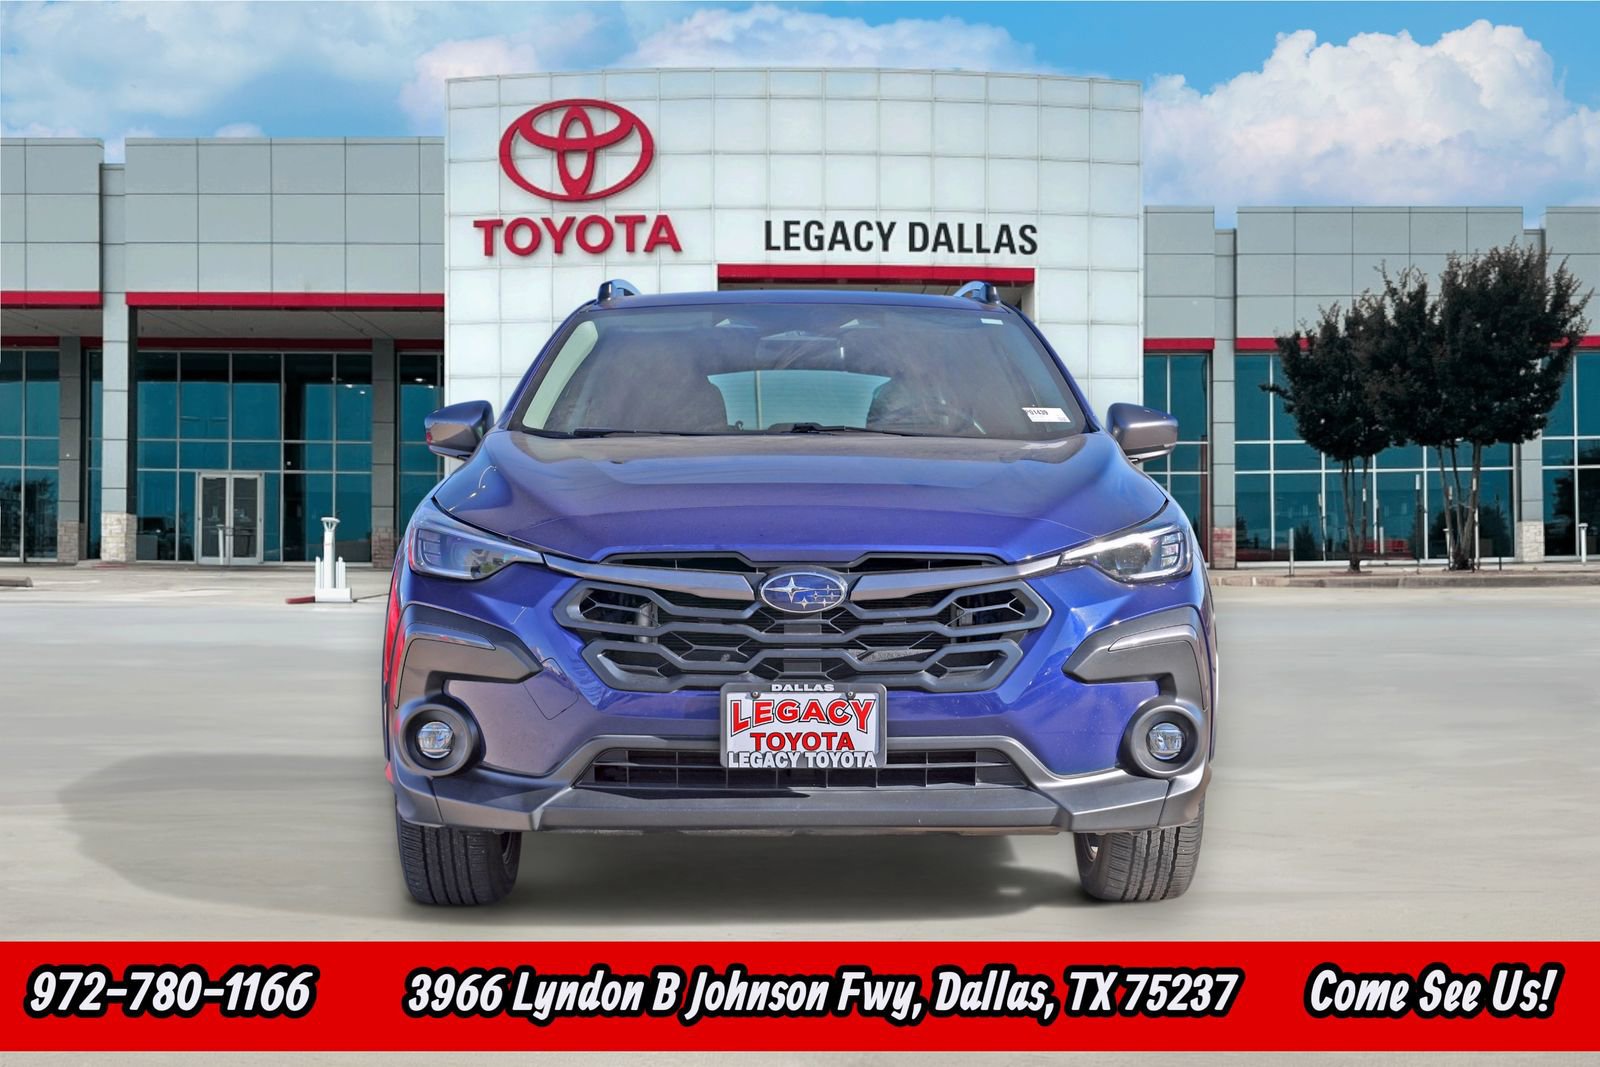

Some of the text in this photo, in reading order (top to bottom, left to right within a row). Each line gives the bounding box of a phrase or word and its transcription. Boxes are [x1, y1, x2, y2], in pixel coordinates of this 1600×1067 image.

[473, 215, 682, 256] TOYOTA
[765, 220, 1038, 255] LEGACY DALLAS
[771, 683, 835, 692] DALLAS
[731, 698, 876, 737] LEGACY
[750, 731, 855, 752] TOYOTA
[727, 750, 877, 769] LEGACY TOYOTA
